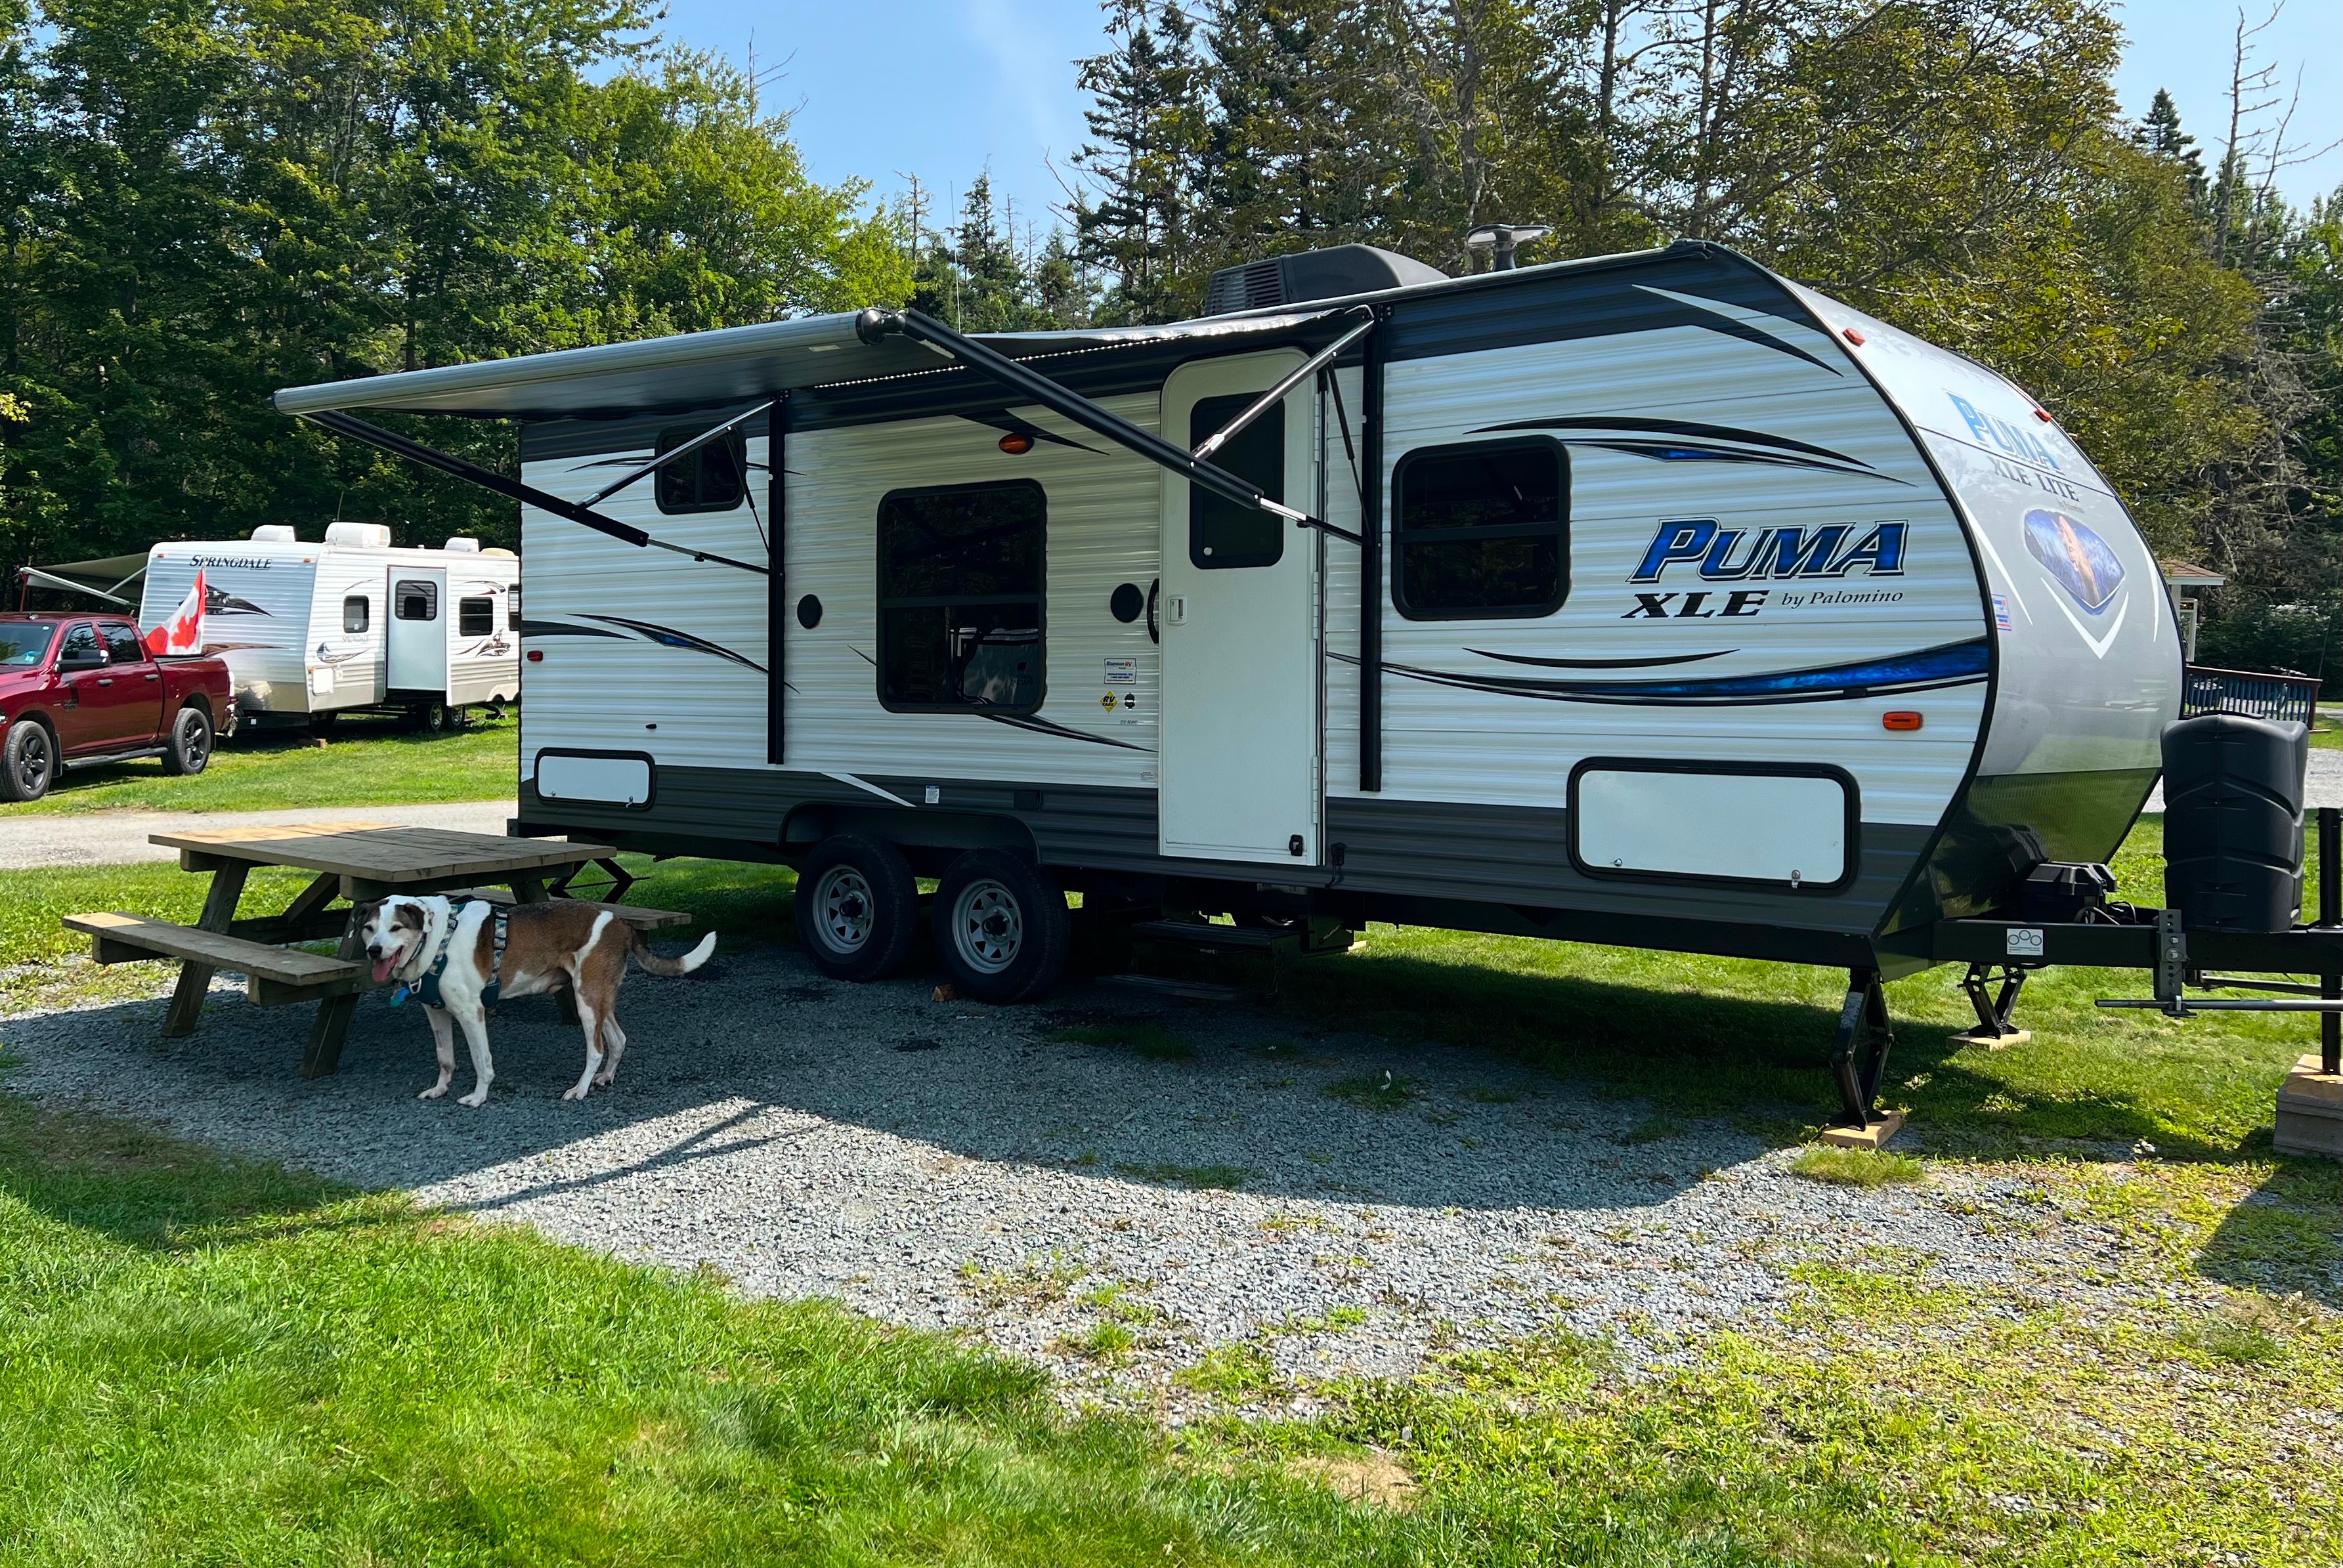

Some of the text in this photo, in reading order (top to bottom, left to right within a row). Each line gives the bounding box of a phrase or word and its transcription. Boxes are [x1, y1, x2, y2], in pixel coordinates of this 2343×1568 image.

[1942, 388, 2065, 477] PUMA
[1987, 456, 2080, 502] XLE LITE
[189, 554, 272, 569] SPRINGDALE
[1625, 516, 1910, 585] PUMA
[1620, 589, 1904, 619] XLE by Palomino
